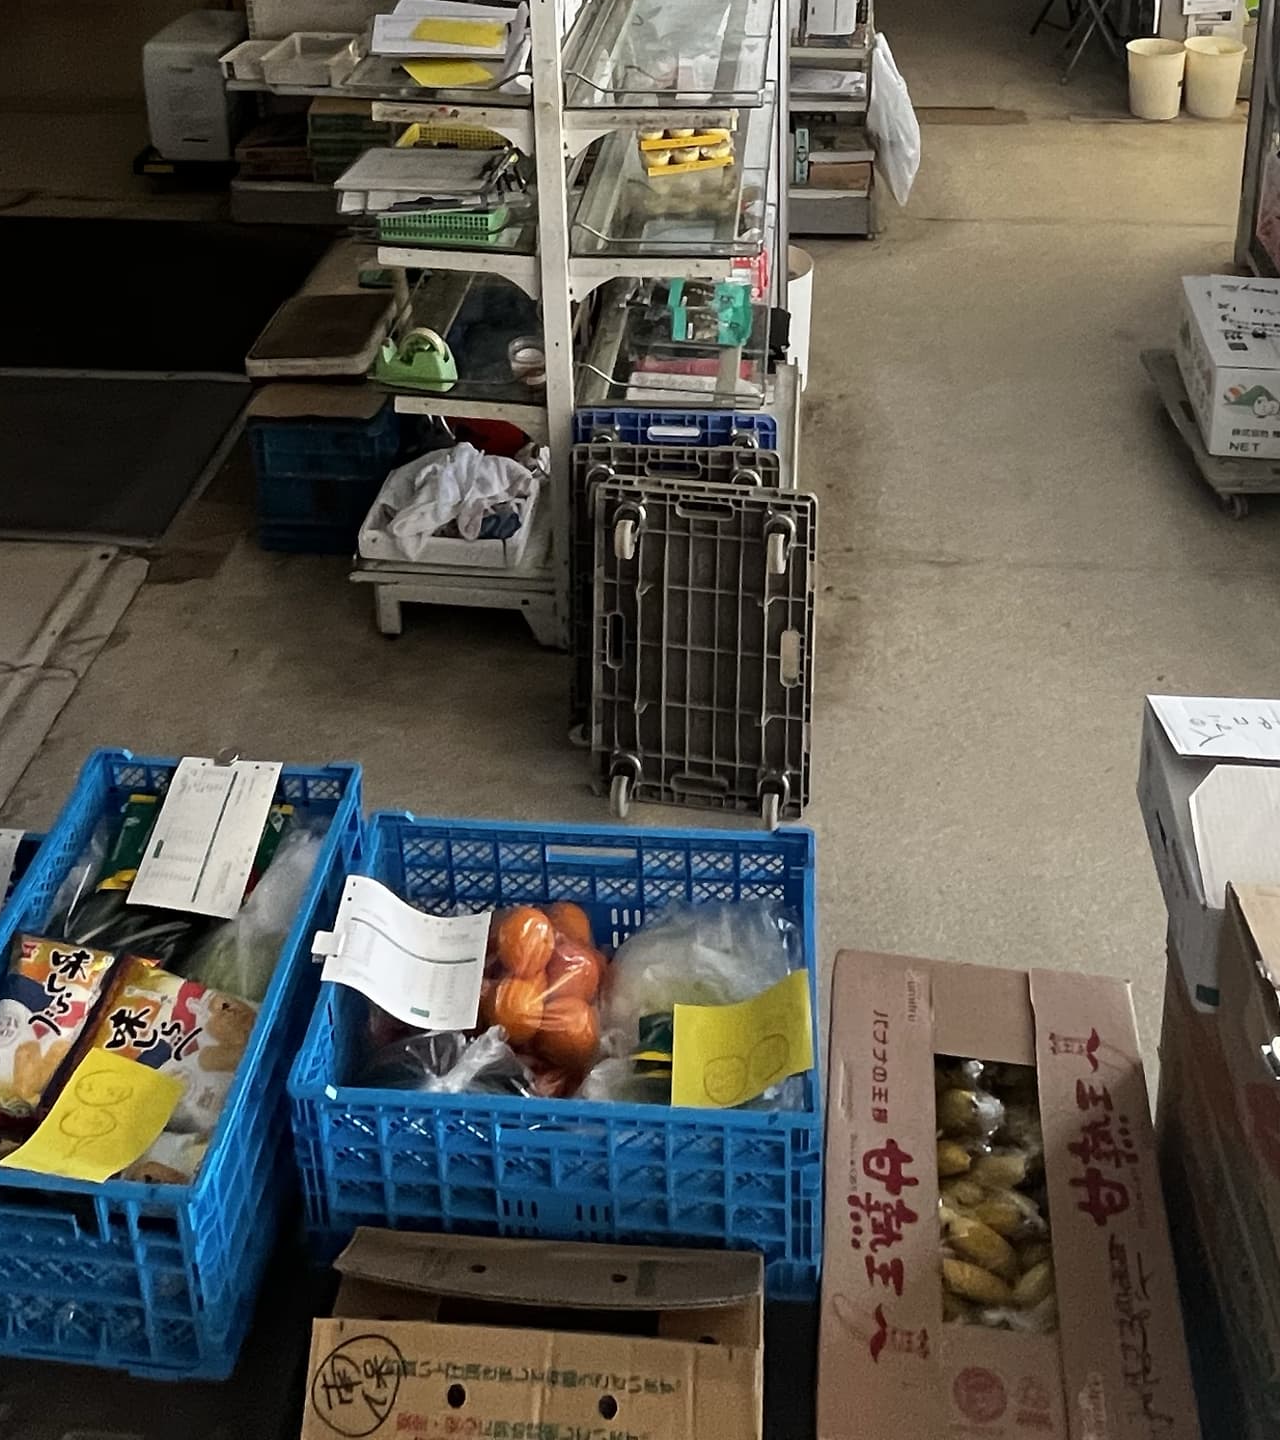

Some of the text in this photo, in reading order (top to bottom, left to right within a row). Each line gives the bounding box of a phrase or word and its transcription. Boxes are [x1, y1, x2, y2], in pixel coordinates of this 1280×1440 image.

[1228, 441, 1261, 453] NET
[28, 949, 94, 1037] 味しらべ
[104, 1007, 204, 1062] 味しらべ
[1067, 1078, 1140, 1228] 甘熟王
[847, 1136, 920, 1298] 甘熟王
